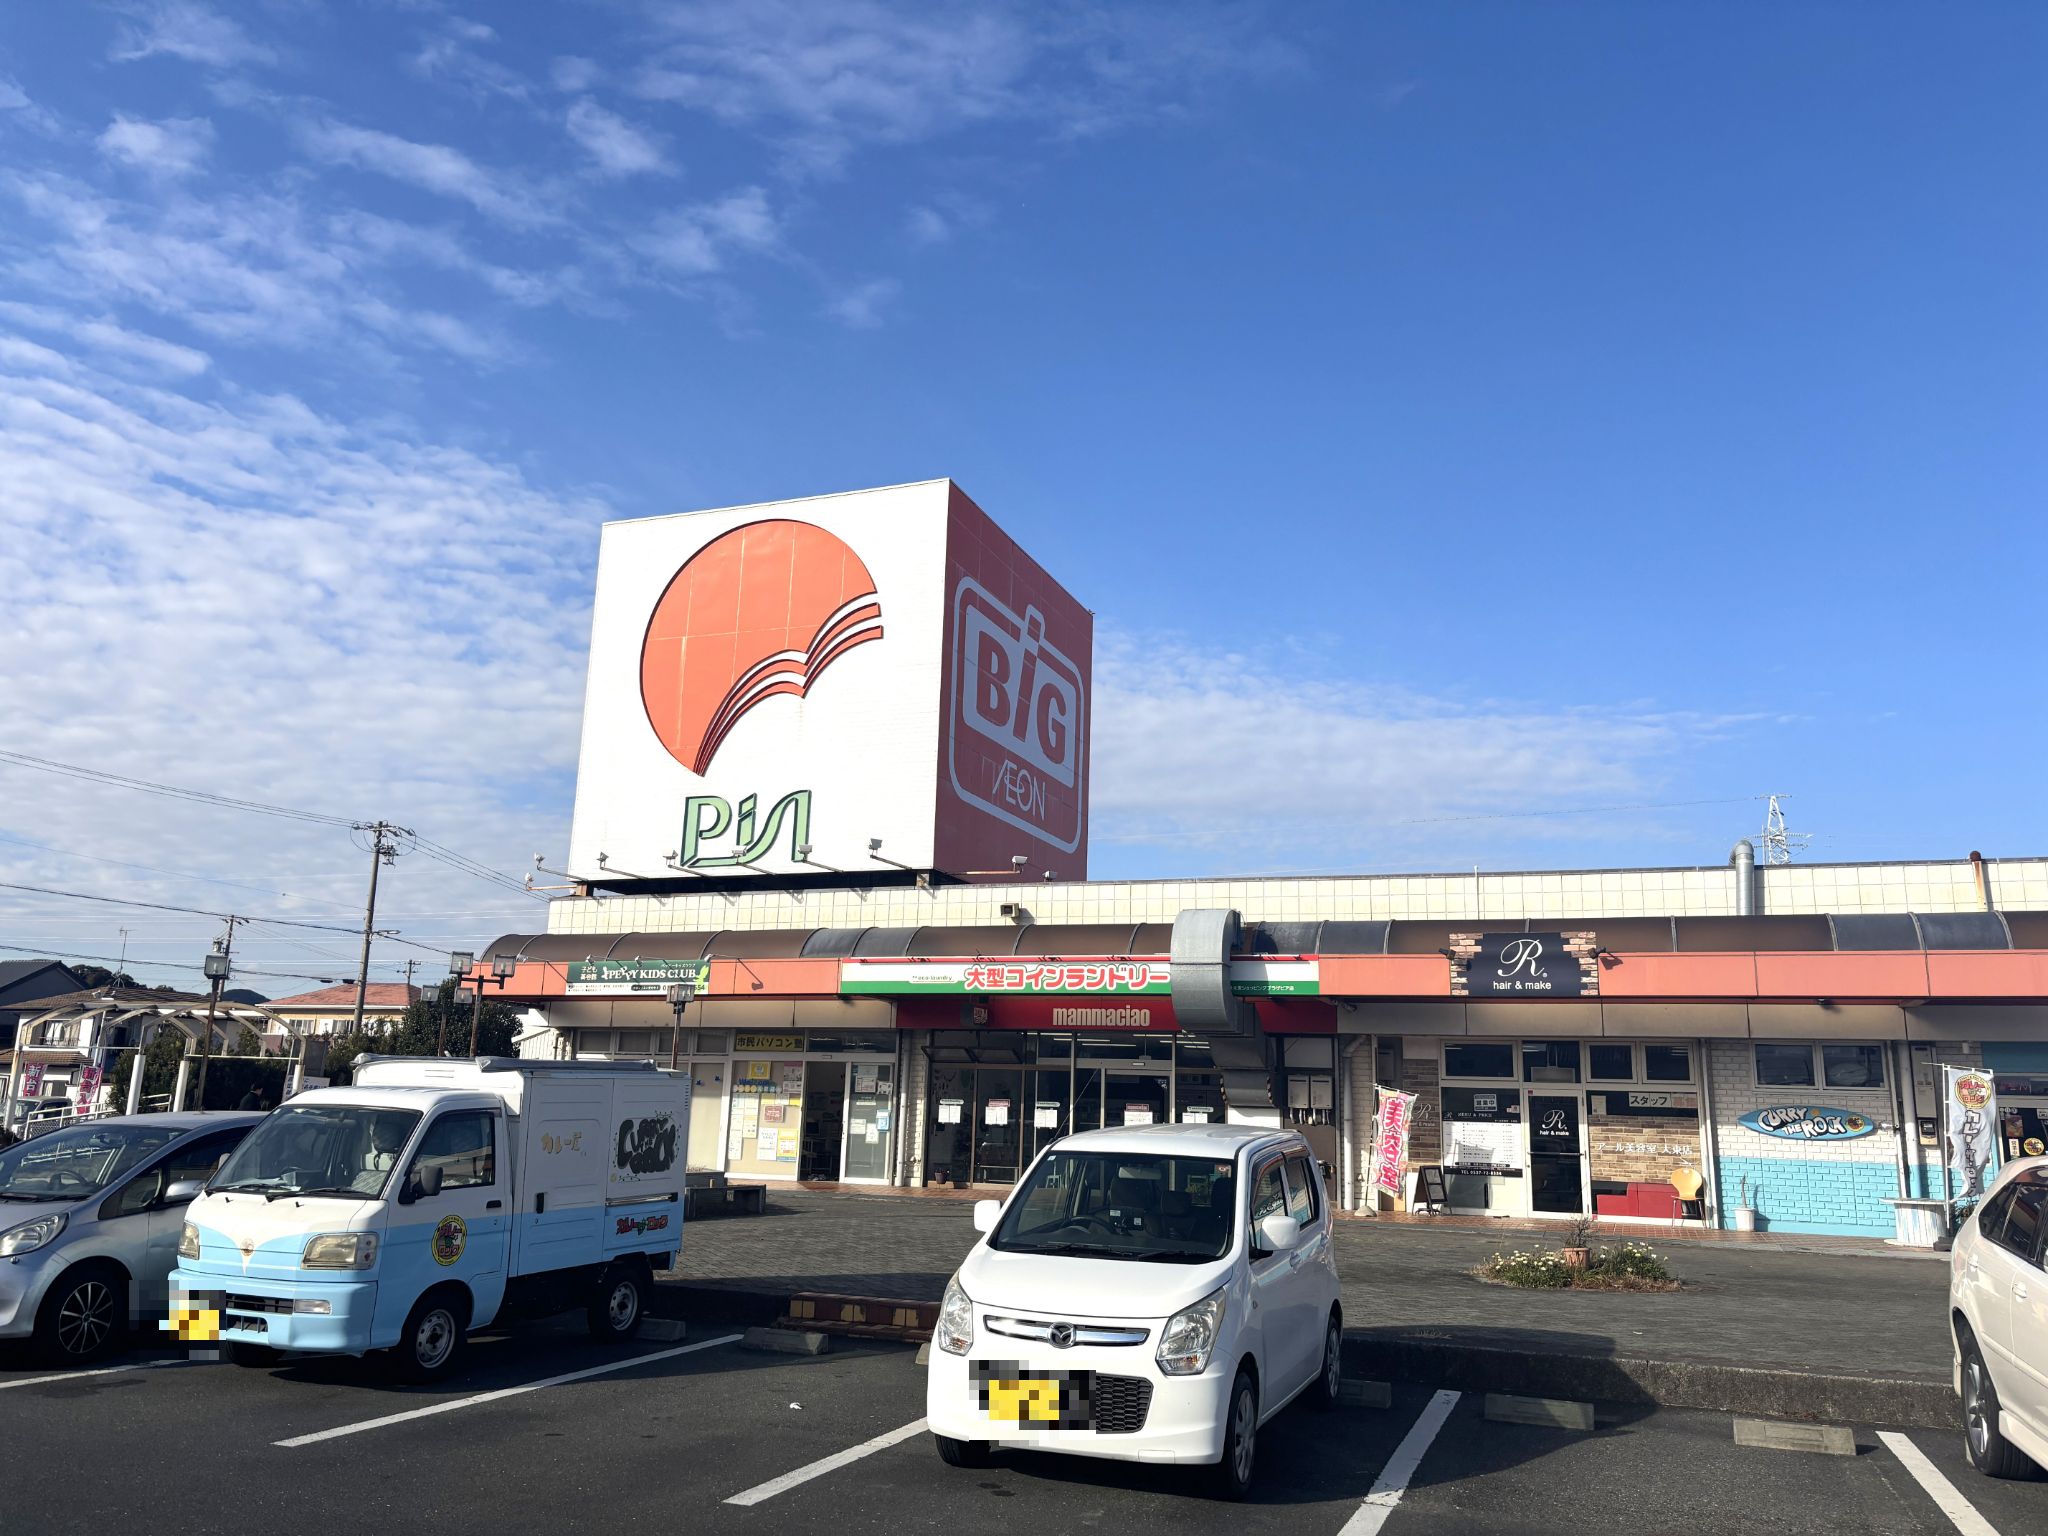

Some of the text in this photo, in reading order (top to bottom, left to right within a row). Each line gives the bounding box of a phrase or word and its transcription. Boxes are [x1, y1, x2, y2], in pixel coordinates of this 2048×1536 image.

[609, 966, 696, 980] PEPPY KIDS CLUB
[965, 966, 1170, 989] 大型コインランドリー
[1493, 981, 1551, 990] hair & make
[1053, 1005, 1150, 1027] mammaciao
[1630, 1095, 1668, 1105] スタッフ
[1757, 1107, 1808, 1131] CURRY
[1783, 1123, 1802, 1135] THE
[1800, 1116, 1846, 1138] ROCK
[1380, 1098, 1406, 1192] 美容室
[1595, 1142, 1694, 1155] アール美容室 大東店
